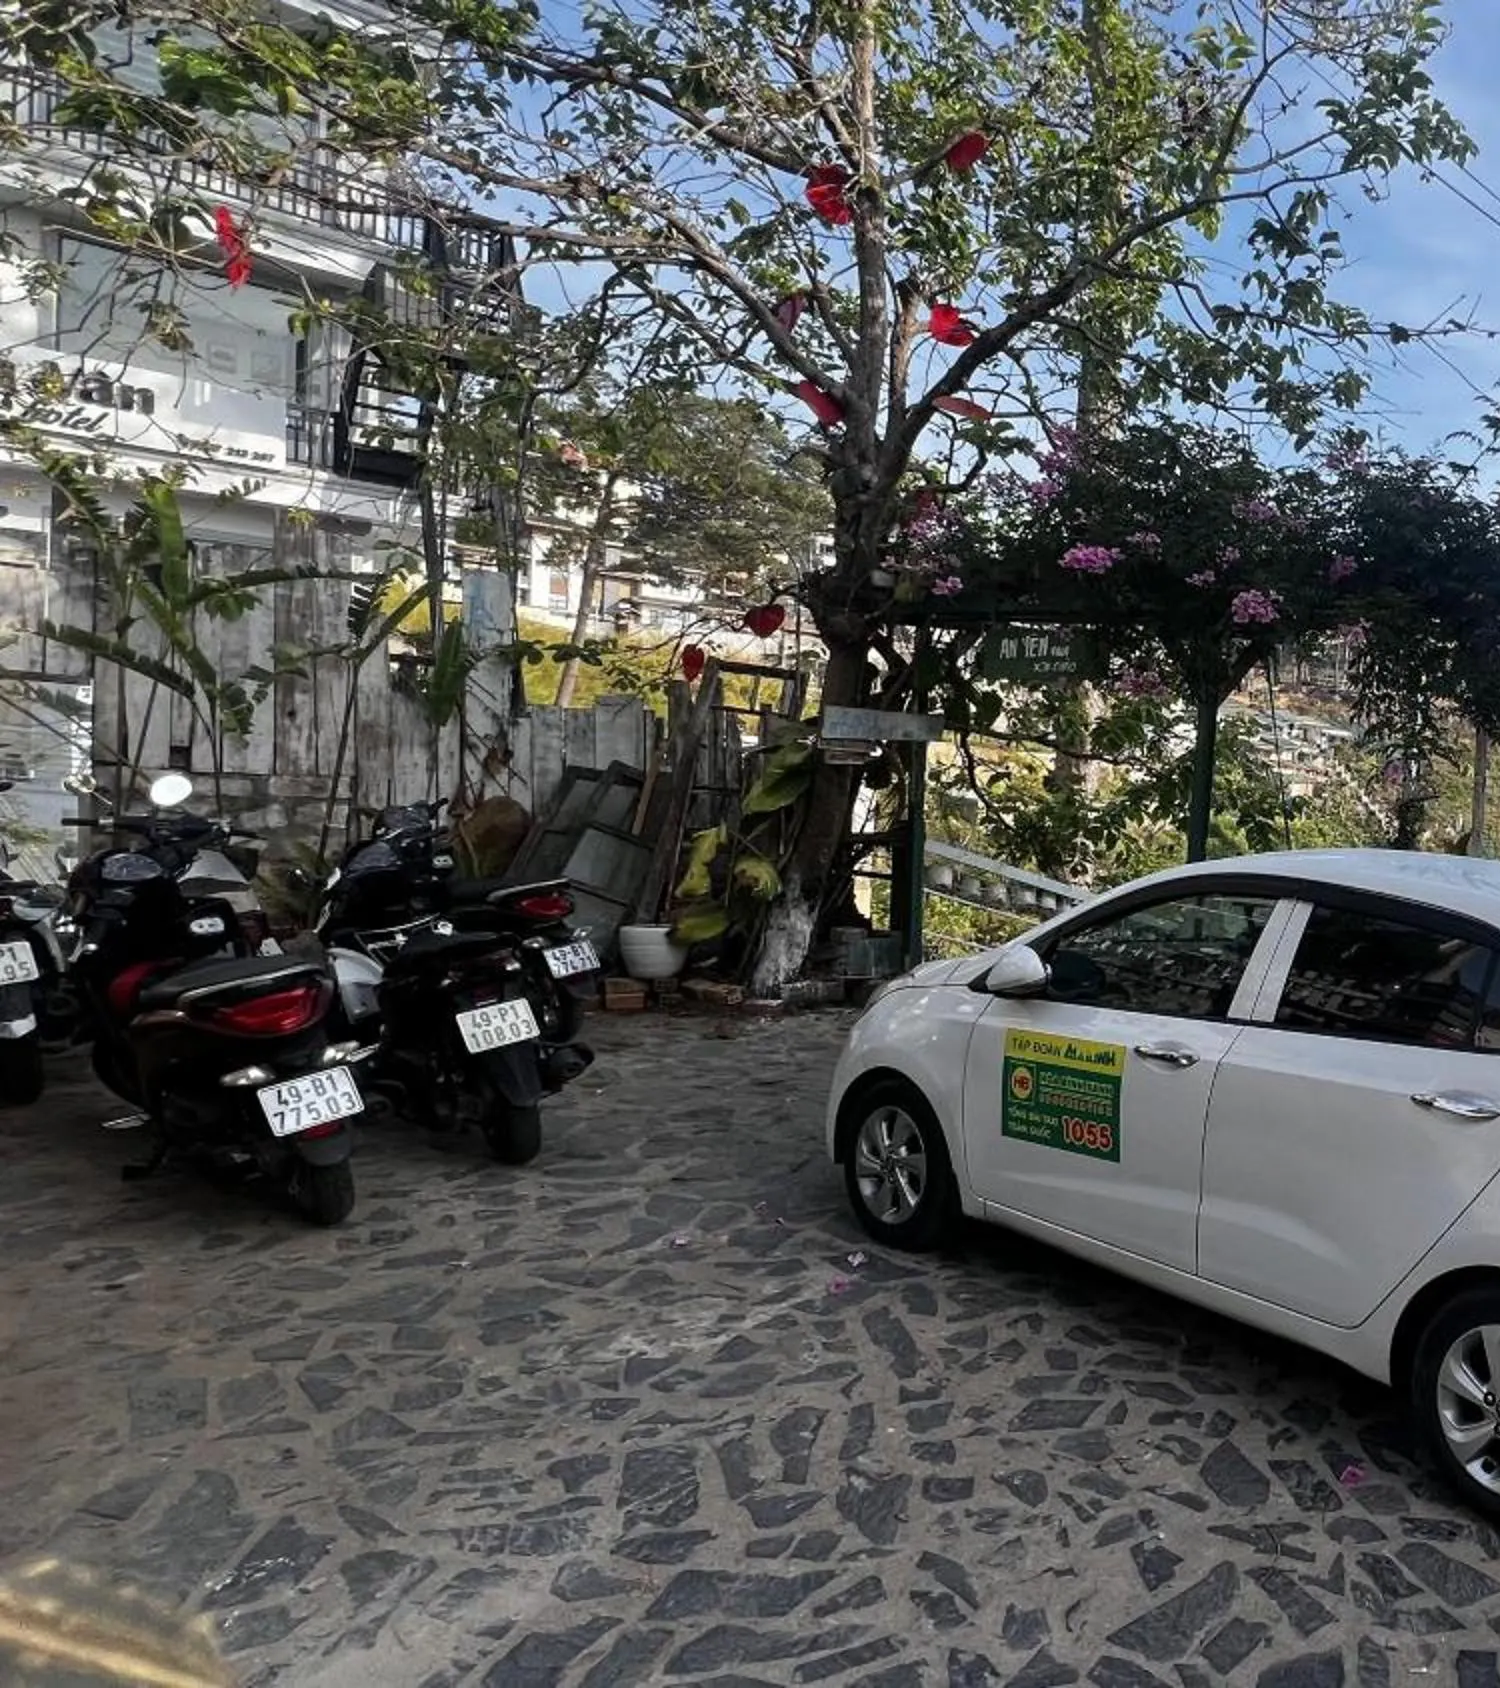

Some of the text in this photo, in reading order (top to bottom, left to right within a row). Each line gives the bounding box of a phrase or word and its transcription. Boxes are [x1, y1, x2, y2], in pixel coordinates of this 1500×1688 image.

[1000, 637, 1018, 660] AN
[471, 1004, 520, 1029] 49-P1
[471, 1019, 533, 1049] 108.03
[277, 1073, 338, 1106] 49-B1
[273, 1091, 356, 1131] 775.03
[1061, 1115, 1113, 1151] 1055
